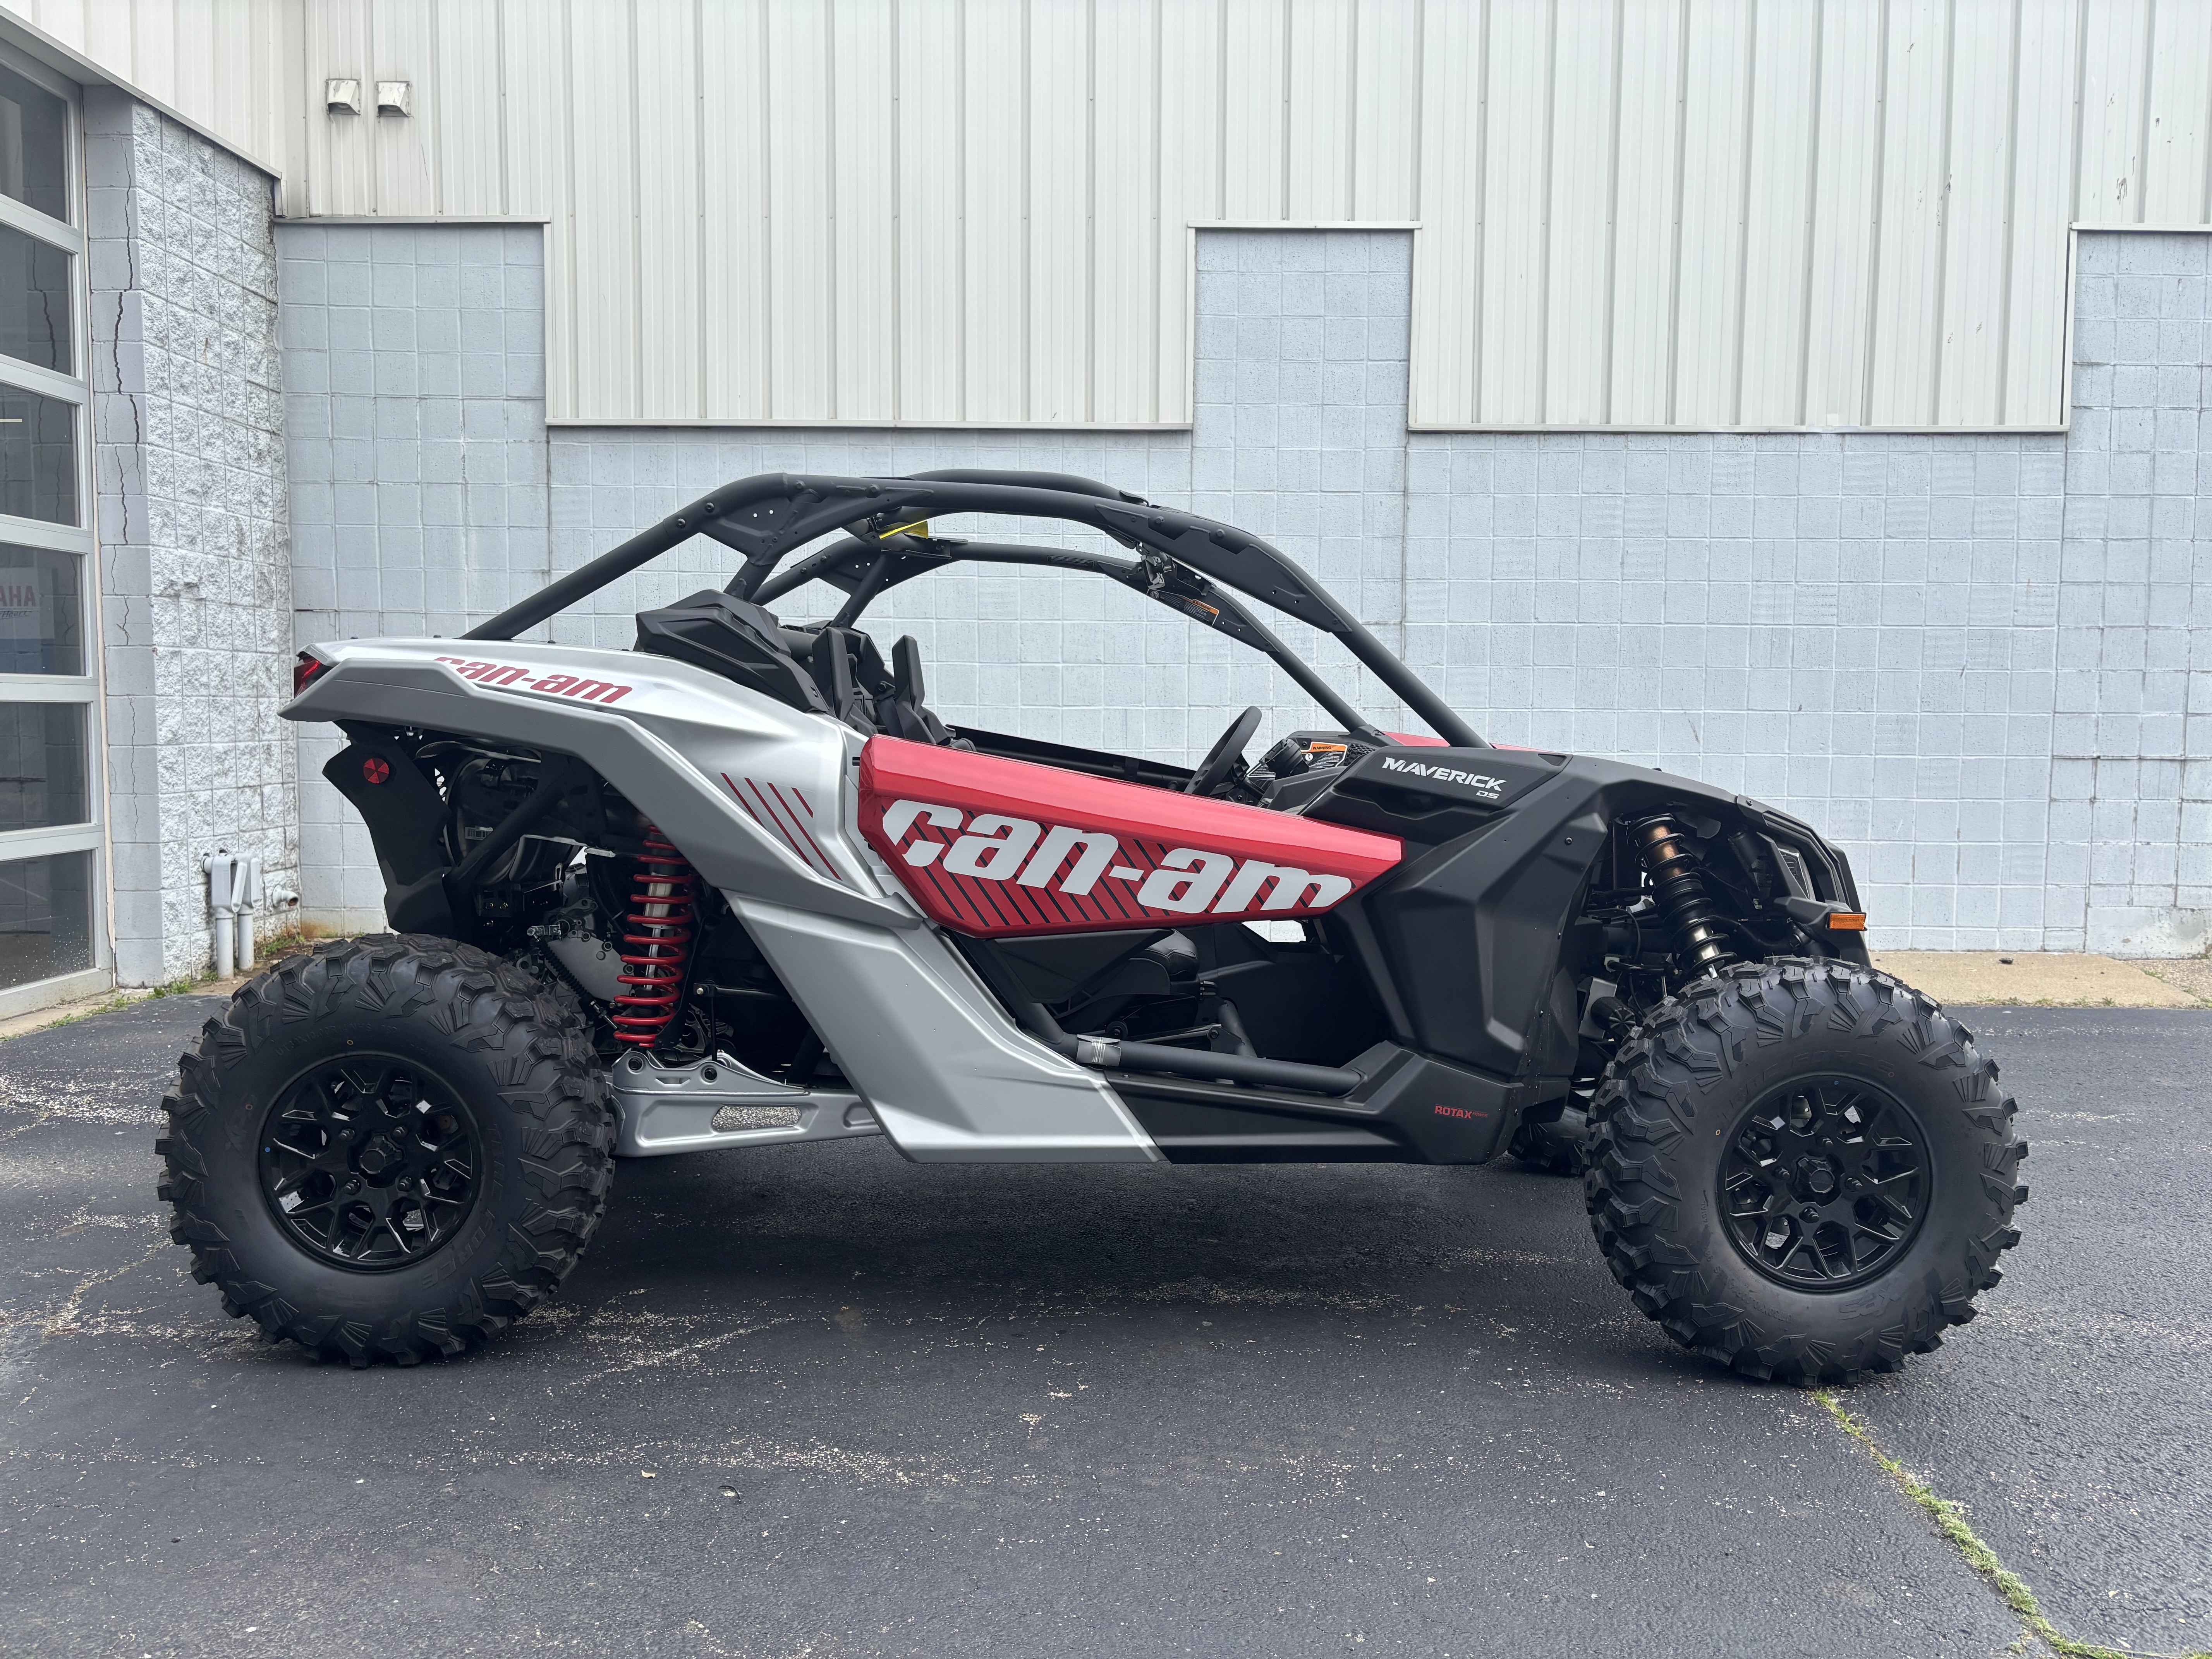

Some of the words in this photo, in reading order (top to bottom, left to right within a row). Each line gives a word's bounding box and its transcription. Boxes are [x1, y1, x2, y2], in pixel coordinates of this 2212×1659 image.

[1382, 757, 1507, 792] MAVERICK
[1476, 790, 1499, 799] DS
[883, 799, 1352, 914] can-am
[1435, 1105, 1472, 1119] ROTAX
